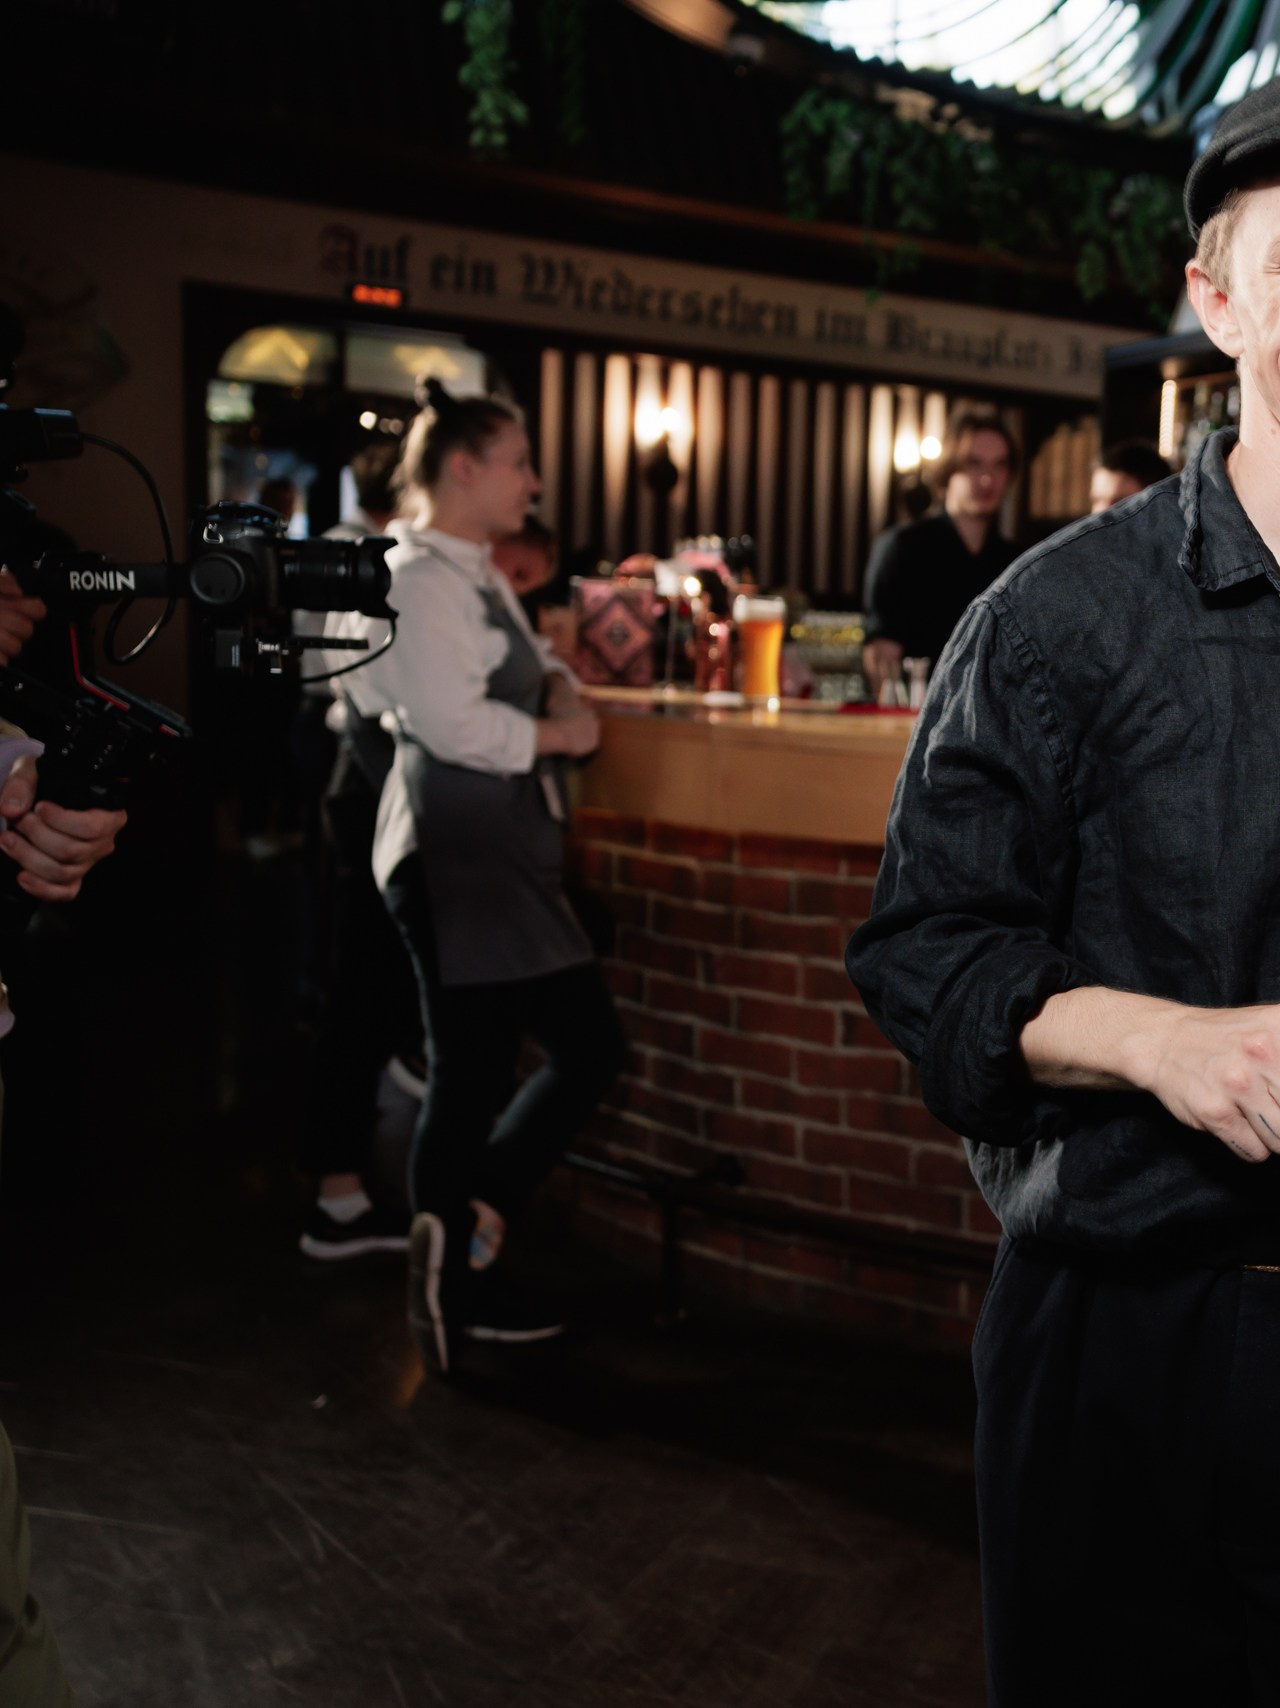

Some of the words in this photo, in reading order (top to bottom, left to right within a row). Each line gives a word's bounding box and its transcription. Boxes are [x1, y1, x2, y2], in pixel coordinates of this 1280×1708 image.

[319, 223, 412, 280] Auf
[430, 241, 497, 295] ein
[519, 251, 799, 337] Wiedersehen
[69, 570, 135, 591] RONIN
